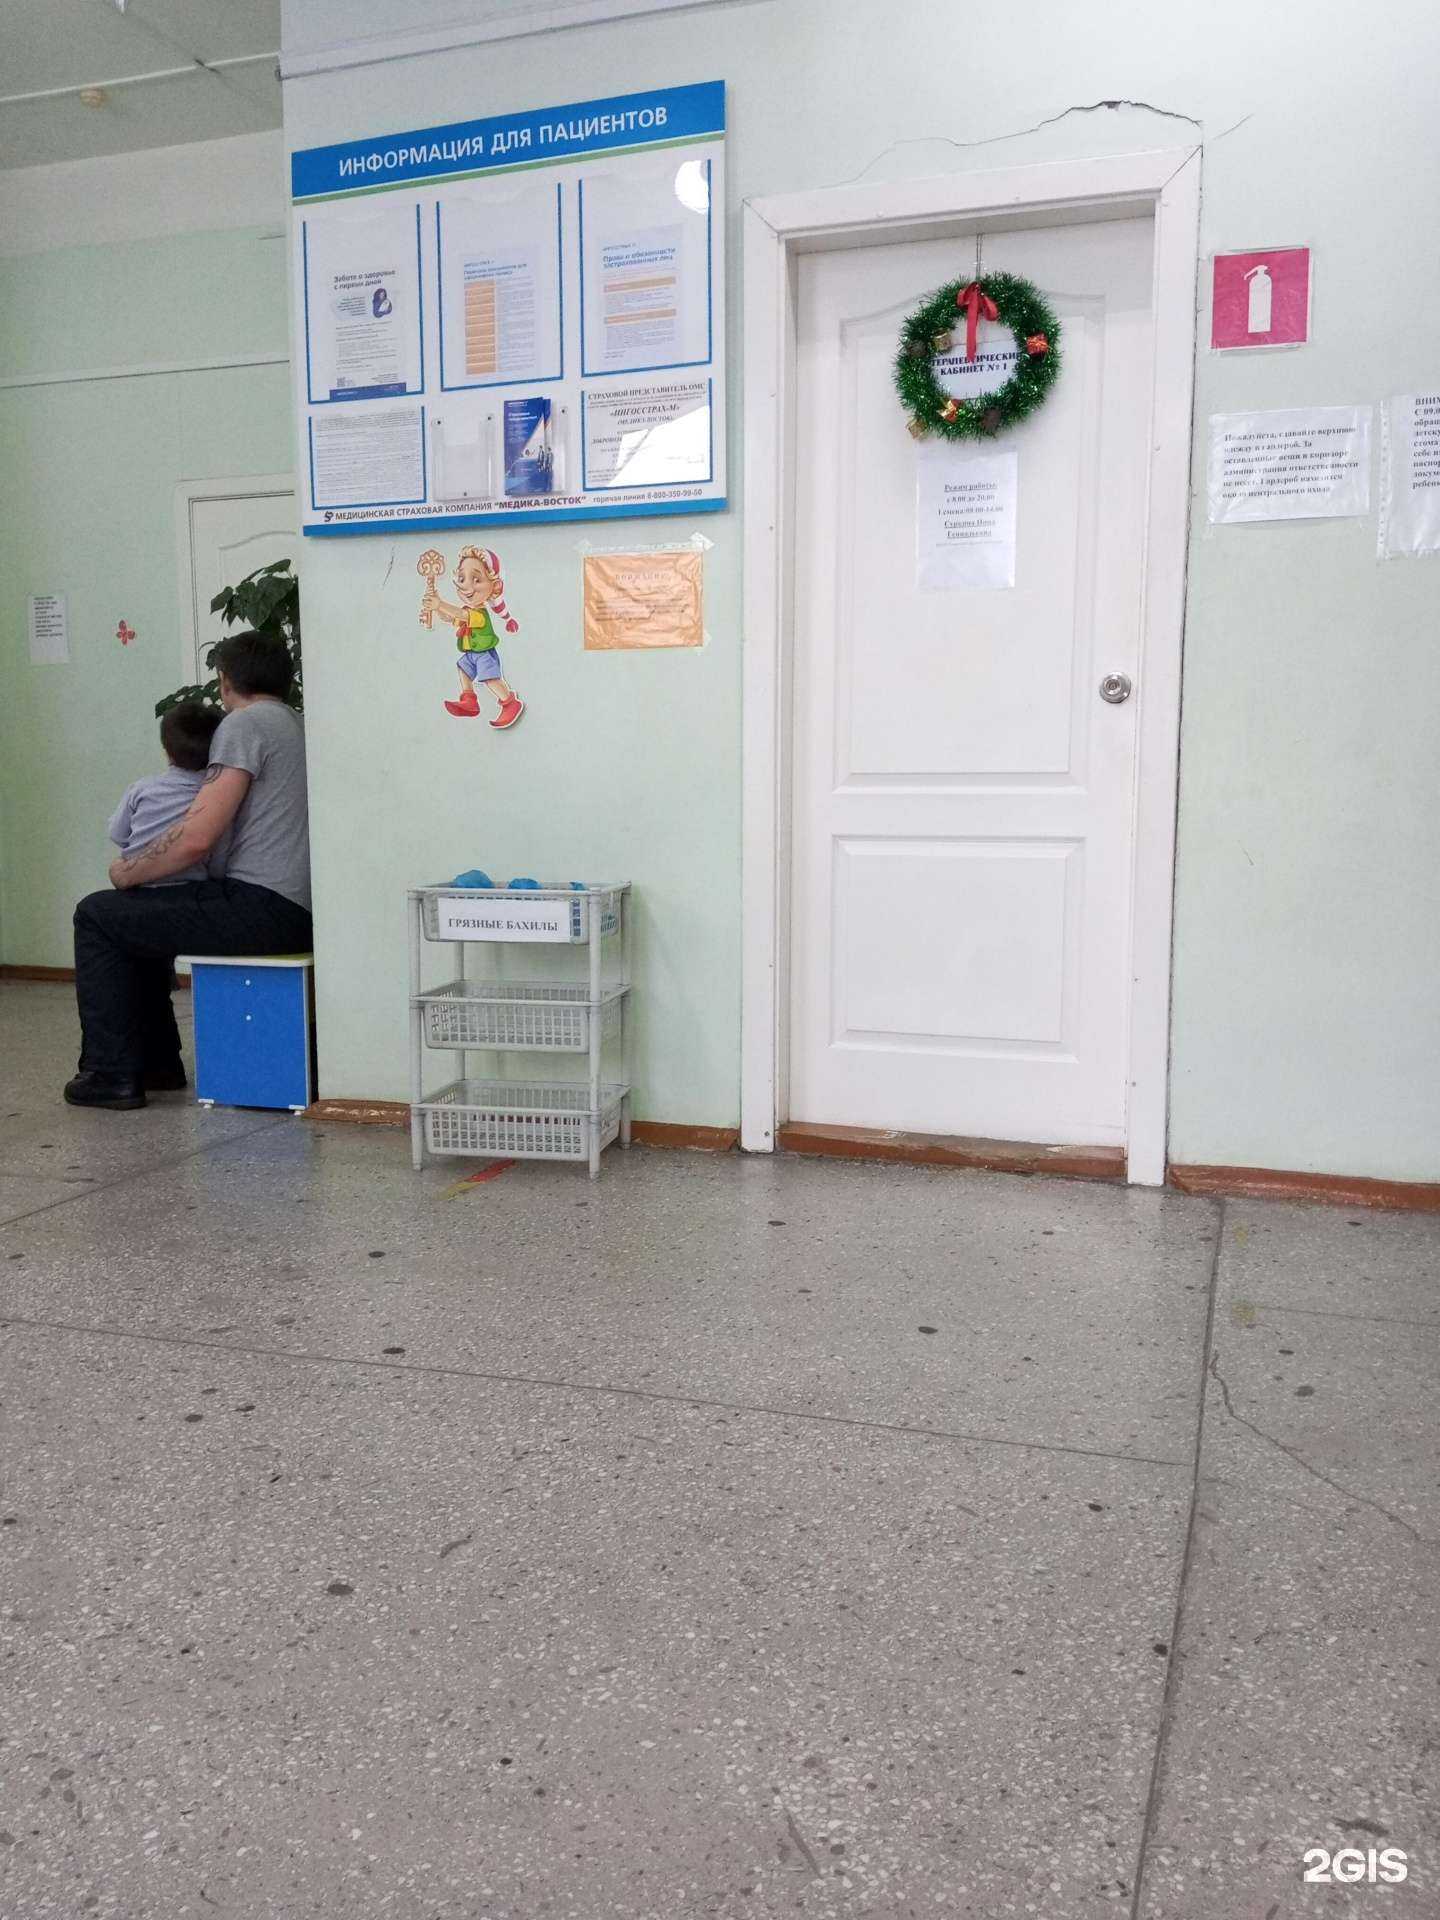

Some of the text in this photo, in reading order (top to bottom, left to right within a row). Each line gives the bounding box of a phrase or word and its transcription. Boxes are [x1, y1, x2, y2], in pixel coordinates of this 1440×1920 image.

[339, 106, 668, 177] ИНФОРМАЦИЯ ДЛЯ ПАЦИЕНТОВ
[932, 351, 1020, 366] ТЕРАПЕИЧЕСКИ
[940, 364, 984, 375] КАБИНЕТ
[335, 509, 395, 521] МЕДИЦИНСКАЯ
[397, 505, 443, 517] СТРАХОВАЯ
[445, 502, 493, 513] КОМПАНИЯ
[448, 918, 558, 932] ГРЯЗНЫЕ БАХИЛЫ
